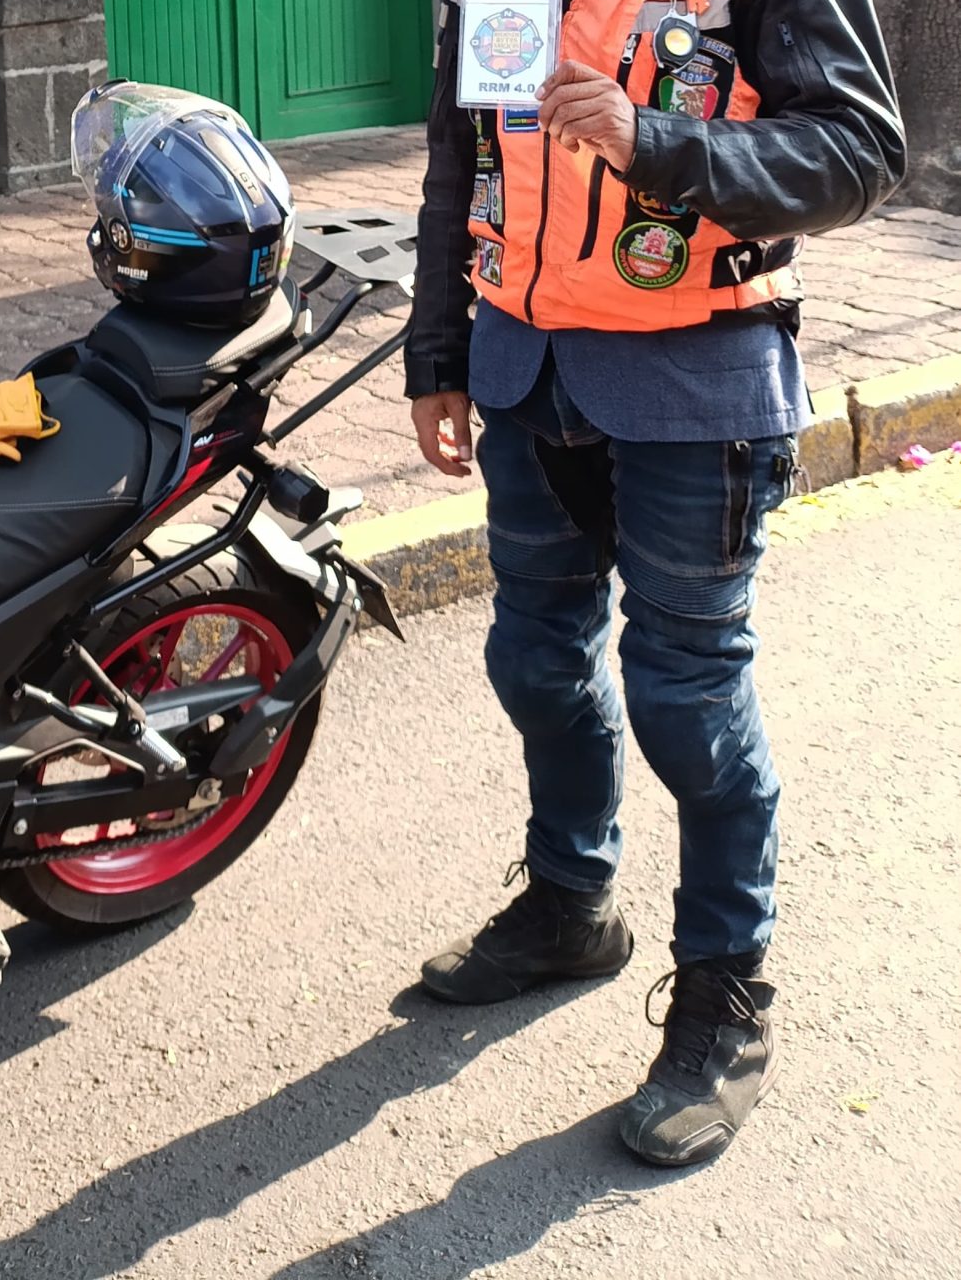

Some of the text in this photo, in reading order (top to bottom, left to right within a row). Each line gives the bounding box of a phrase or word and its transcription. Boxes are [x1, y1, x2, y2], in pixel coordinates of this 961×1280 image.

[479, 82, 536, 94] RRM 4.0
[117, 264, 149, 281] NOLAN
